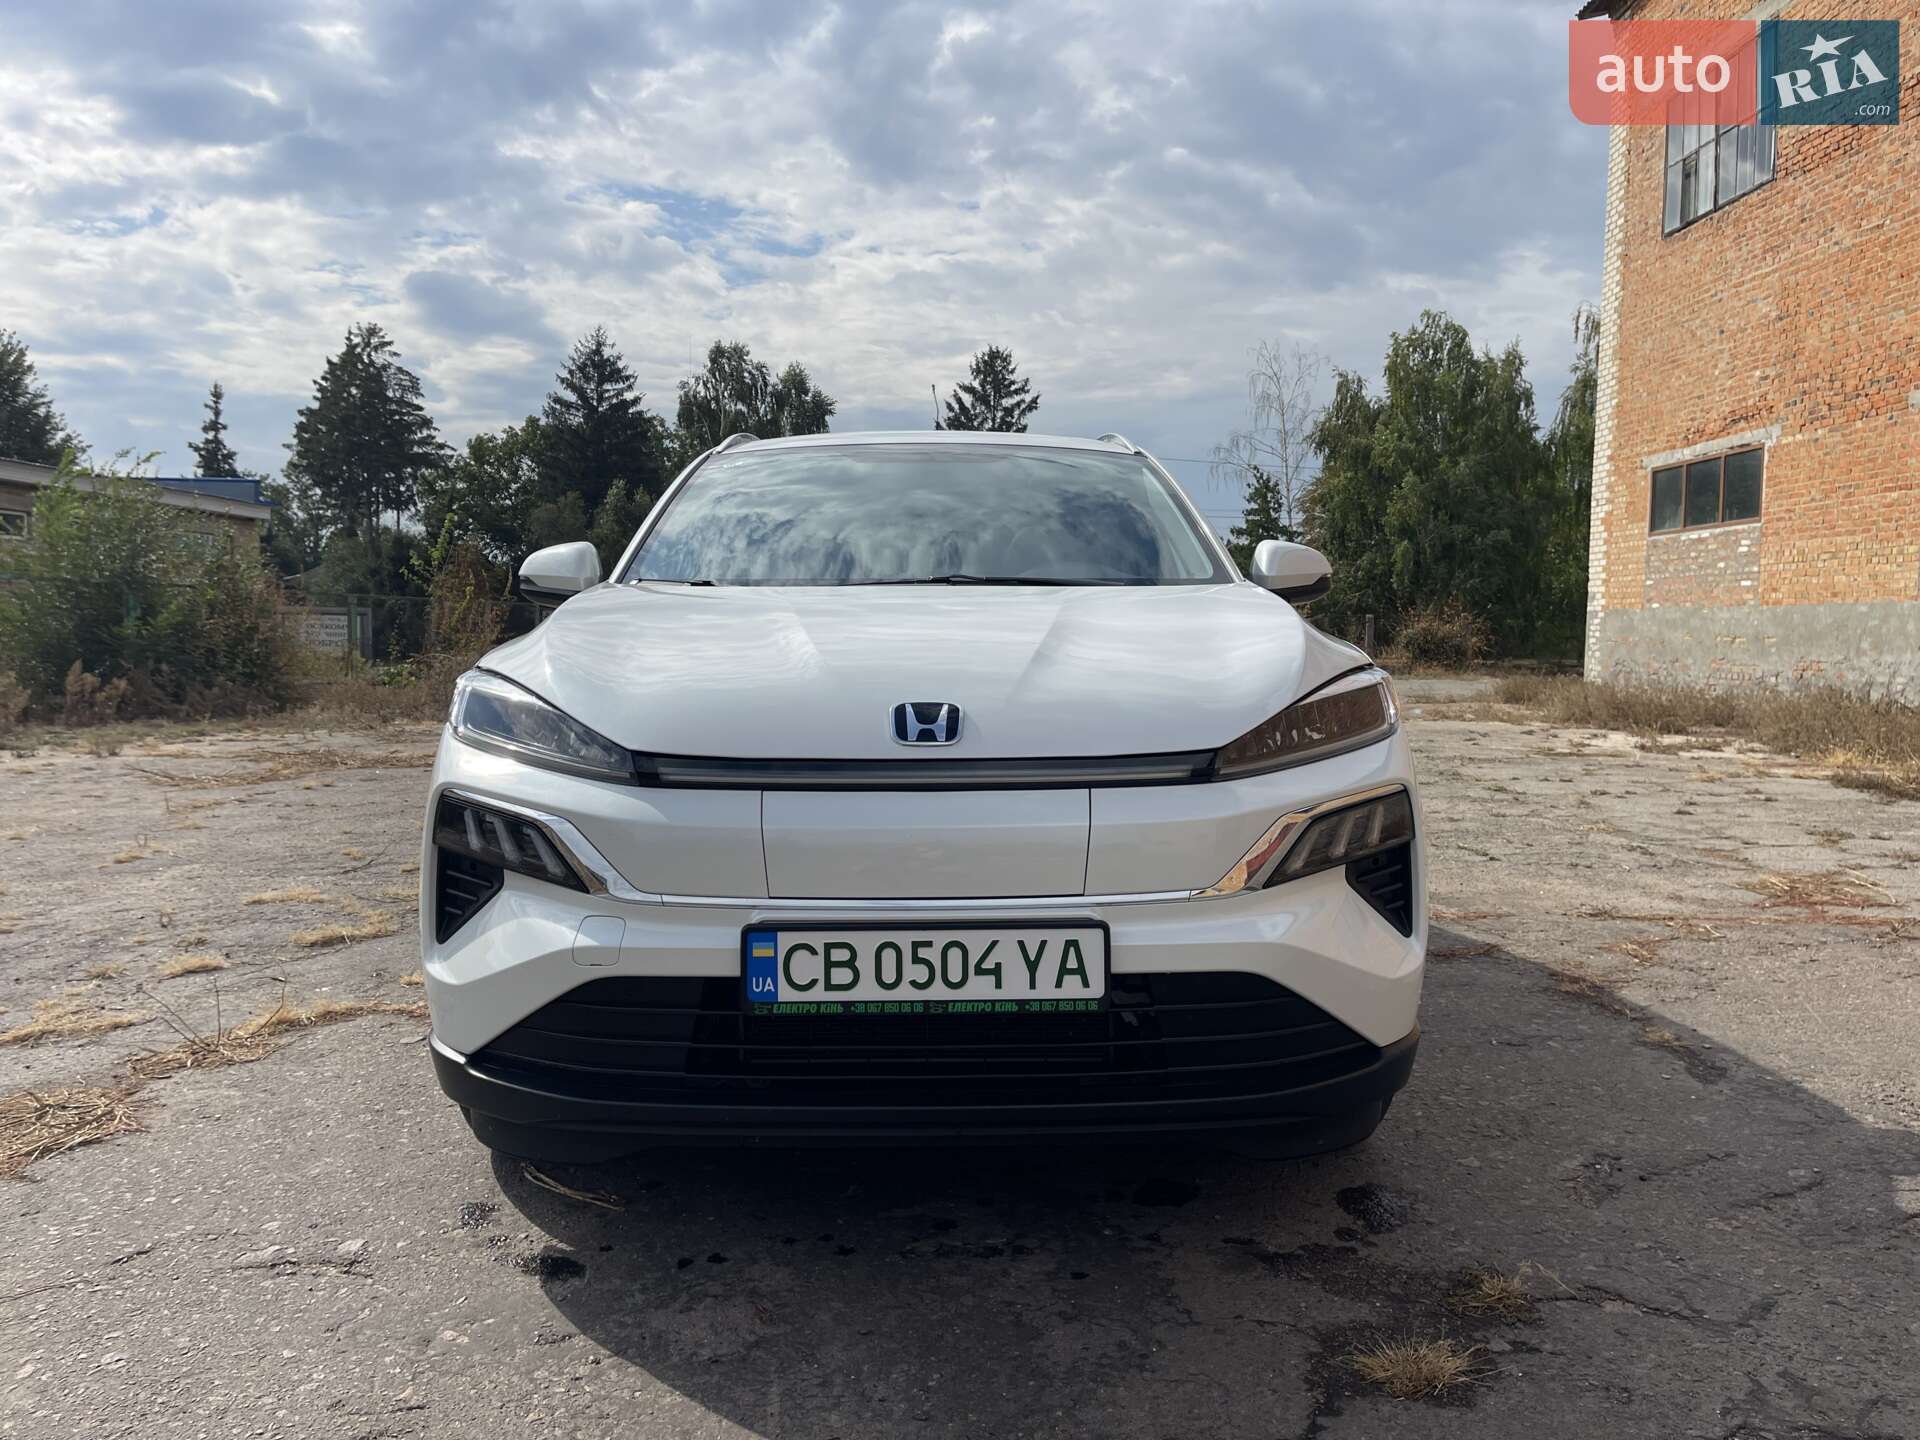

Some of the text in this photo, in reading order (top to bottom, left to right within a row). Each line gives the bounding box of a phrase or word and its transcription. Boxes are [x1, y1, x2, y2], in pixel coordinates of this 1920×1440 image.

[874, 940, 1003, 990] 0504
[1016, 939, 1091, 989] YA
[752, 977, 776, 993] UA
[773, 1003, 817, 1014] ЕЛЕКТРО
[948, 1002, 992, 1013] ЕЛЕКТРО
